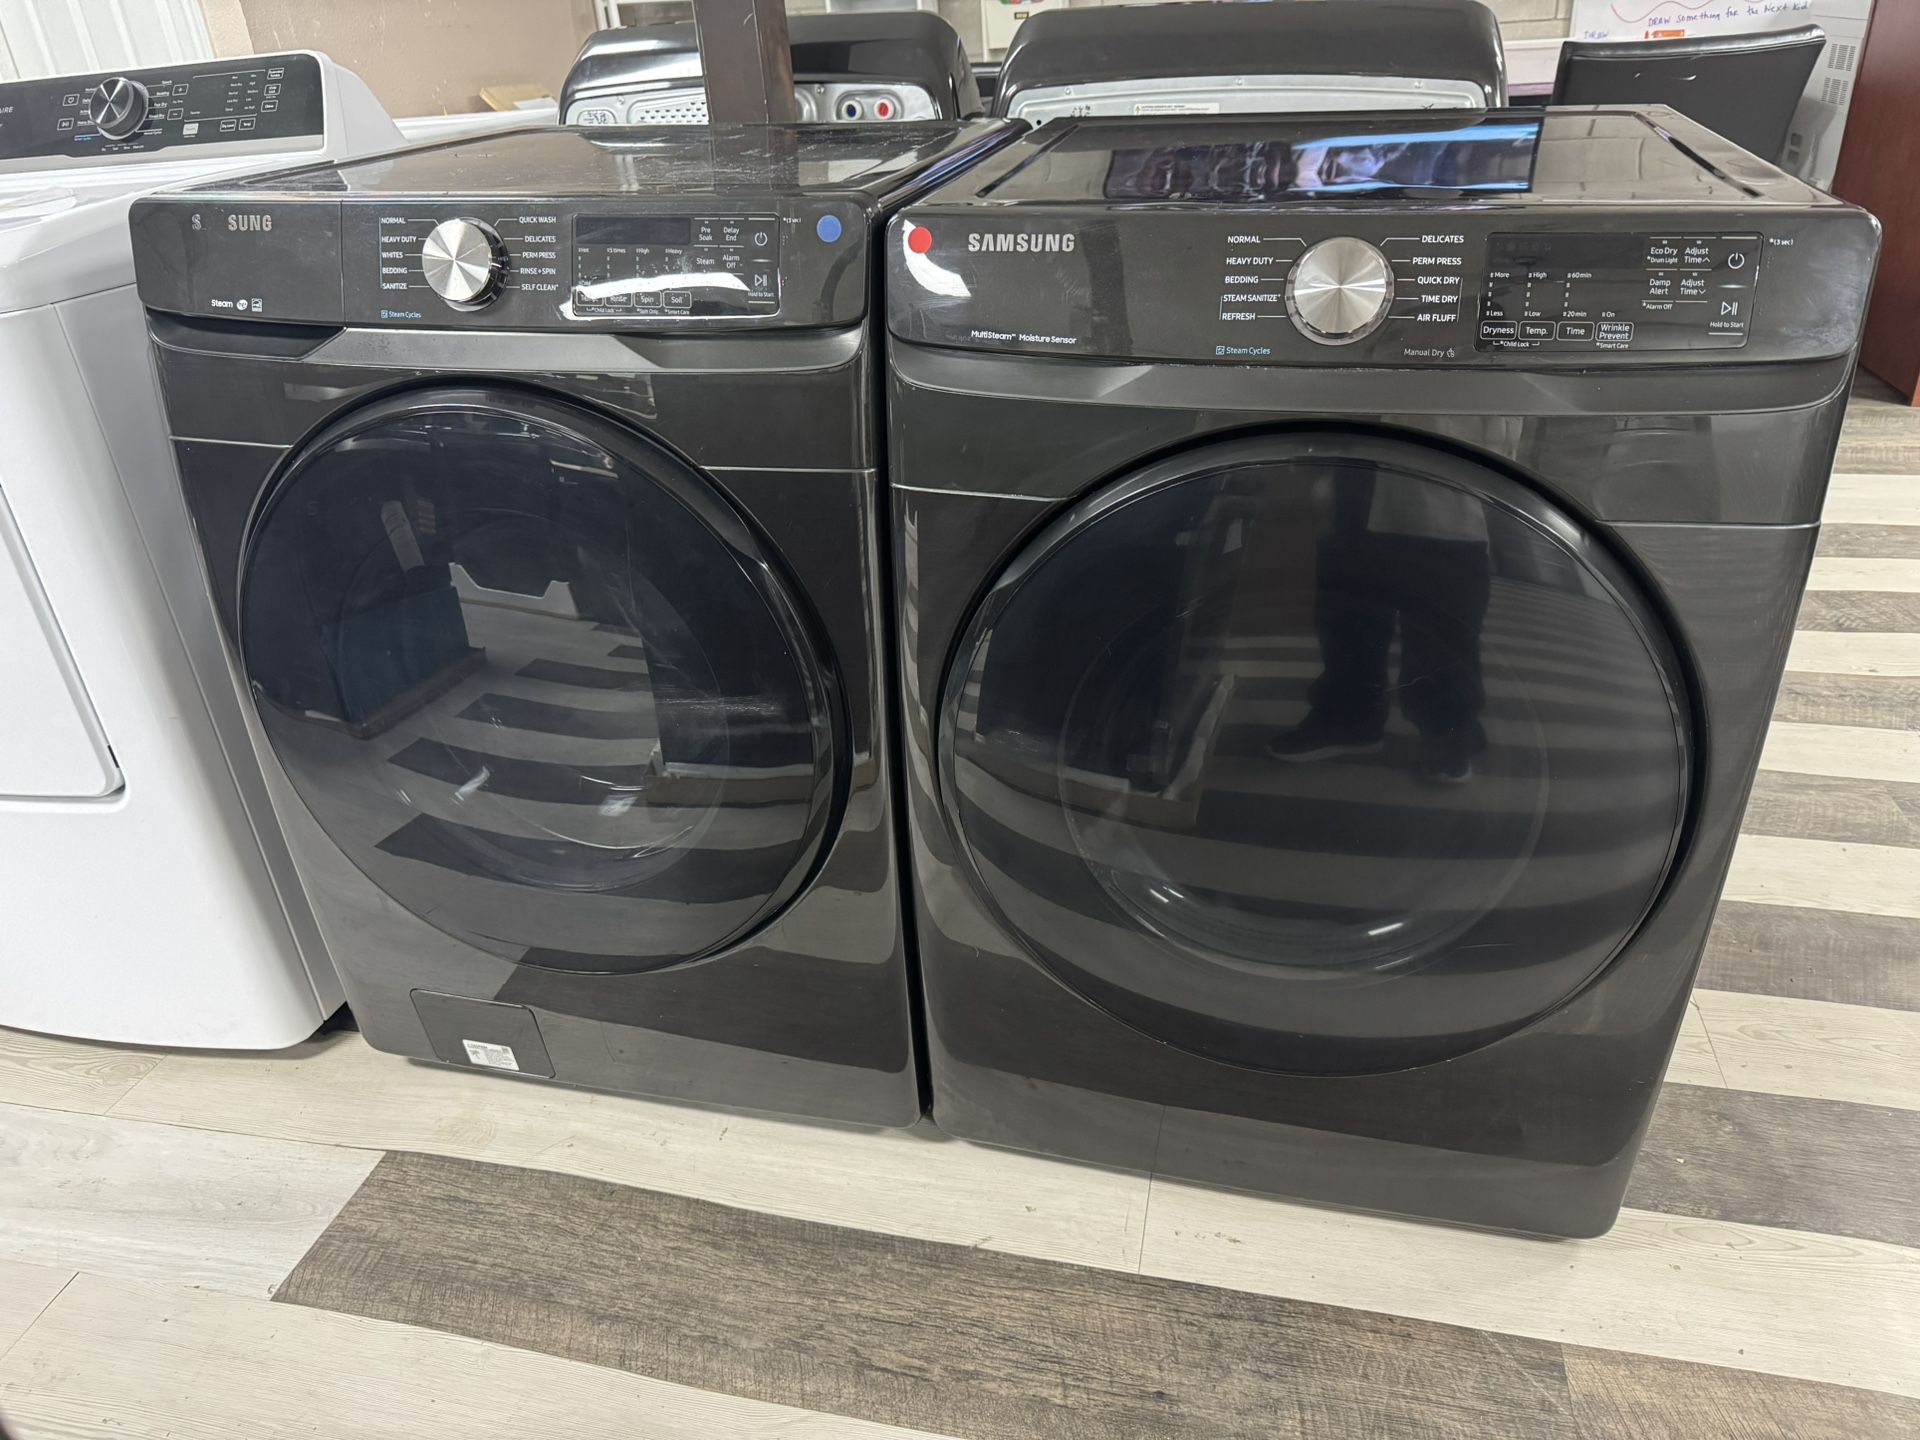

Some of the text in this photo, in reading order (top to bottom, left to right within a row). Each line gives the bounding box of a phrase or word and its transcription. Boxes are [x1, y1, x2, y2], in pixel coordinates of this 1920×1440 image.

[1648, 17, 1671, 27] DRAW
[519, 216, 538, 224] QUICK
[968, 233, 1075, 252] SAMSUNG
[1422, 235, 1464, 243] DELICATES
[1664, 247, 1678, 256] Dry
[1685, 246, 1709, 256] Adjust
[1226, 257, 1274, 265] HEAVY DUTY
[1412, 257, 1462, 265] PERM PRESS
[1417, 276, 1442, 285] QUICK
[1649, 279, 1671, 287] Damp
[1681, 279, 1704, 288] Adjust
[1649, 287, 1668, 295] Alert
[640, 296, 654, 304] Spin
[1223, 294, 1247, 302] STEAM
[1421, 295, 1458, 303] TIME DRY
[211, 299, 233, 308] Steam
[406, 311, 421, 319] Cycles
[1417, 314, 1456, 322] AIR FLUFF
[1483, 326, 1514, 335] Dryness
[1526, 327, 1548, 336] Temp.
[1566, 327, 1585, 335] Time
[1600, 324, 1630, 332] Wrinkle
[1019, 334, 1050, 343] Moisture
[1051, 335, 1077, 344] Sensor
[1599, 332, 1630, 340] Prevent
[1248, 347, 1271, 356] Cycles
[1404, 348, 1444, 358] Manual Dry
